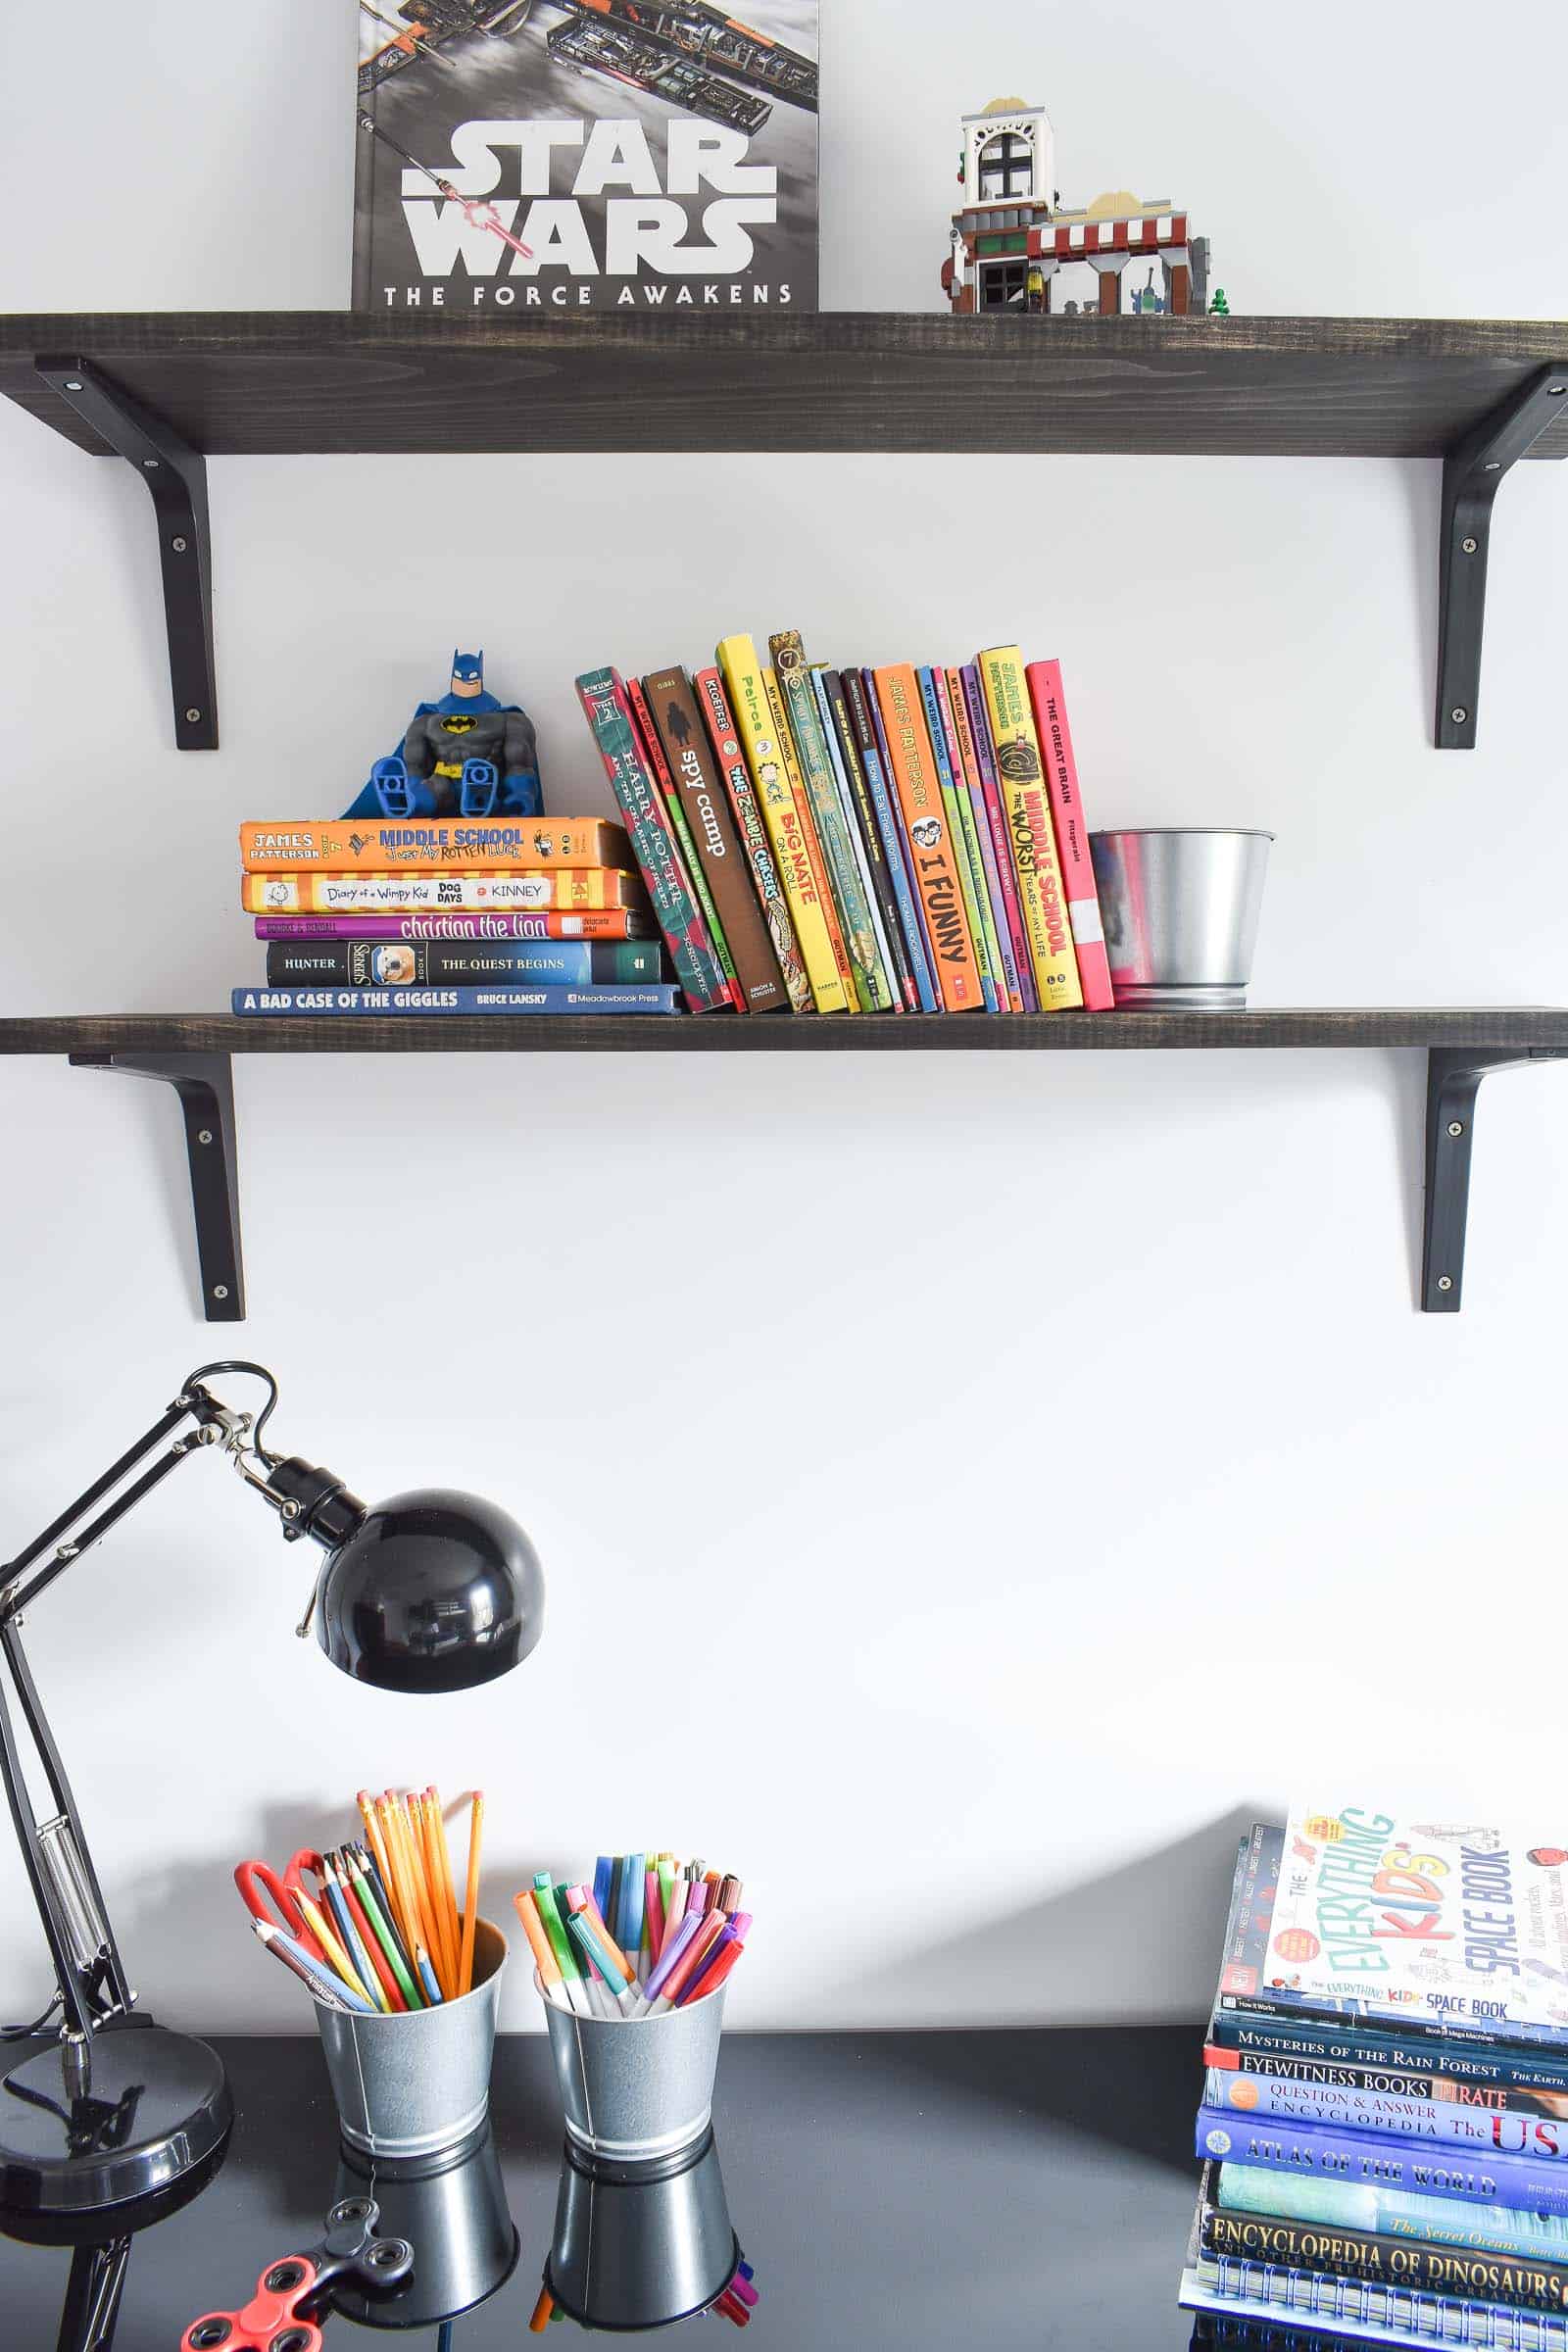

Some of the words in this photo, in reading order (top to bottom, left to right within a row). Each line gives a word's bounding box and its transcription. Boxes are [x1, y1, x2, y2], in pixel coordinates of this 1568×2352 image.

[402, 119, 776, 196] STAR
[401, 198, 776, 275] WARS
[385, 287, 445, 305] THE
[474, 286, 591, 305] FORCE
[618, 284, 792, 305] AWAKENS
[783, 652, 793, 666] 7
[705, 678, 730, 732] KLOEPFER
[742, 676, 762, 731] Peirce
[888, 676, 911, 723] JAMES
[924, 684, 932, 697] MY
[990, 662, 1009, 729] PATTERSON
[1002, 662, 1024, 724] JAMES
[767, 686, 777, 700] MY
[772, 701, 785, 730] WEIRD
[779, 731, 793, 762] SCHOOL
[928, 699, 940, 727] WEIRD
[955, 693, 965, 722] WEIRD
[1047, 698, 1058, 722] THE
[933, 729, 946, 760] SCHOOL
[959, 724, 971, 758] SCHOOL
[972, 698, 982, 726] WEIRD
[977, 728, 989, 759] SCHOOL
[1052, 725, 1064, 762] GREAT
[760, 741, 769, 753] 3
[611, 757, 624, 778] AND
[729, 764, 748, 793] THE
[899, 728, 929, 808] PATTERSON
[1012, 792, 1022, 809] THE
[1058, 767, 1072, 804] BRAIN
[681, 751, 705, 789] spy
[697, 794, 726, 857] camp
[867, 760, 881, 783] How
[875, 794, 887, 811] Eat
[884, 839, 899, 871] Worms
[379, 829, 449, 846] MIDDLE
[455, 828, 524, 845] SCHOOL
[622, 750, 656, 823] HARRY
[651, 830, 682, 903] POTTER
[737, 795, 762, 847] ZOMBIE
[250, 850, 319, 859] PATTERSON
[254, 833, 314, 848] JAMES
[385, 843, 419, 860] Just
[421, 845, 438, 860] My
[441, 843, 487, 860] ROTTEN
[487, 843, 520, 858] LUCK
[1010, 809, 1038, 876] WORST
[754, 849, 780, 900] CHASERS
[776, 837, 786, 854] ON
[784, 866, 798, 895] ROLL
[780, 812, 802, 850] BIG
[792, 852, 817, 906] NATE
[918, 854, 947, 872] I
[1023, 790, 1054, 870] MIDDLE
[1039, 876, 1067, 956] SCHOOL
[327, 887, 359, 902] Diary
[359, 887, 369, 898] of
[376, 887, 411, 902] Wimpy
[413, 886, 429, 899] Kid
[437, 893, 463, 903] DAYS
[439, 883, 461, 893] DOG
[492, 886, 541, 897] KINNEY
[1025, 875, 1038, 906] YEARS
[401, 915, 476, 938] christian
[479, 916, 509, 937] the
[512, 916, 546, 937] lion
[924, 875, 967, 963] FUNNY
[1033, 915, 1042, 931] MY
[833, 939, 848, 972] GUTMAN
[975, 938, 987, 970] GUTMAN
[1034, 932, 1046, 957] LIFE
[285, 959, 336, 968] HUNTER
[354, 944, 371, 986] SEEKERS
[442, 959, 466, 969] THE
[470, 958, 514, 970] QUEST
[516, 958, 564, 969] BEGINS
[1004, 955, 1016, 987] GUTMAN
[244, 994, 256, 1008] A
[260, 994, 292, 1008] BAD
[296, 993, 333, 1008] CASE
[337, 993, 359, 1007] OF
[362, 993, 391, 1007] THE
[394, 992, 458, 1007] GIGGLES
[477, 994, 507, 1004] BRUCE
[509, 994, 547, 1004] LANSKY
[577, 994, 637, 1004] Meadowbrook
[638, 994, 660, 1004] Press
[1289, 1874, 1307, 1897] THE
[1316, 1807, 1396, 1971] EVERYTHING
[1460, 1845, 1513, 1904] BOOK
[1463, 1909, 1521, 1976] SPACE
[1327, 1983, 1384, 2000] EVERYTHING
[1427, 1993, 1466, 2013] SPACE
[1472, 1999, 1507, 2019] BOOK
[1239, 2031, 1325, 2055] MYSTERIES
[1331, 2045, 1349, 2057] OF
[1354, 2048, 1388, 2063] THE
[1393, 2050, 1432, 2069] RAIN
[1440, 2057, 1500, 2078] FOREST
[1511, 2071, 1531, 2082] THE
[1243, 2055, 1356, 2087] EYEWITNESS
[1363, 2075, 1428, 2098] BOOKS
[1441, 2083, 1507, 2110] PIRATE
[1270, 2083, 1349, 2107] QUESTION
[1352, 2096, 1366, 2107] &
[1372, 2098, 1436, 2120] ANSWER
[1271, 2100, 1437, 2136] ENCYCLOPEDIA
[1450, 2120, 1486, 2138] The
[1247, 2138, 1313, 2168] ATLAS
[1320, 2152, 1350, 2174] OF
[1357, 2156, 1403, 2182] THE
[1411, 2164, 1497, 2197] WORLD
[1391, 2218, 1417, 2235] The
[1425, 2226, 1466, 2242] Secret
[1469, 2232, 1520, 2251] Oceans
[1213, 2218, 1382, 2270] ENCYCLOPEDIA
[1390, 2249, 1420, 2275] OF
[1428, 2255, 1561, 2299] DINOSAURS
